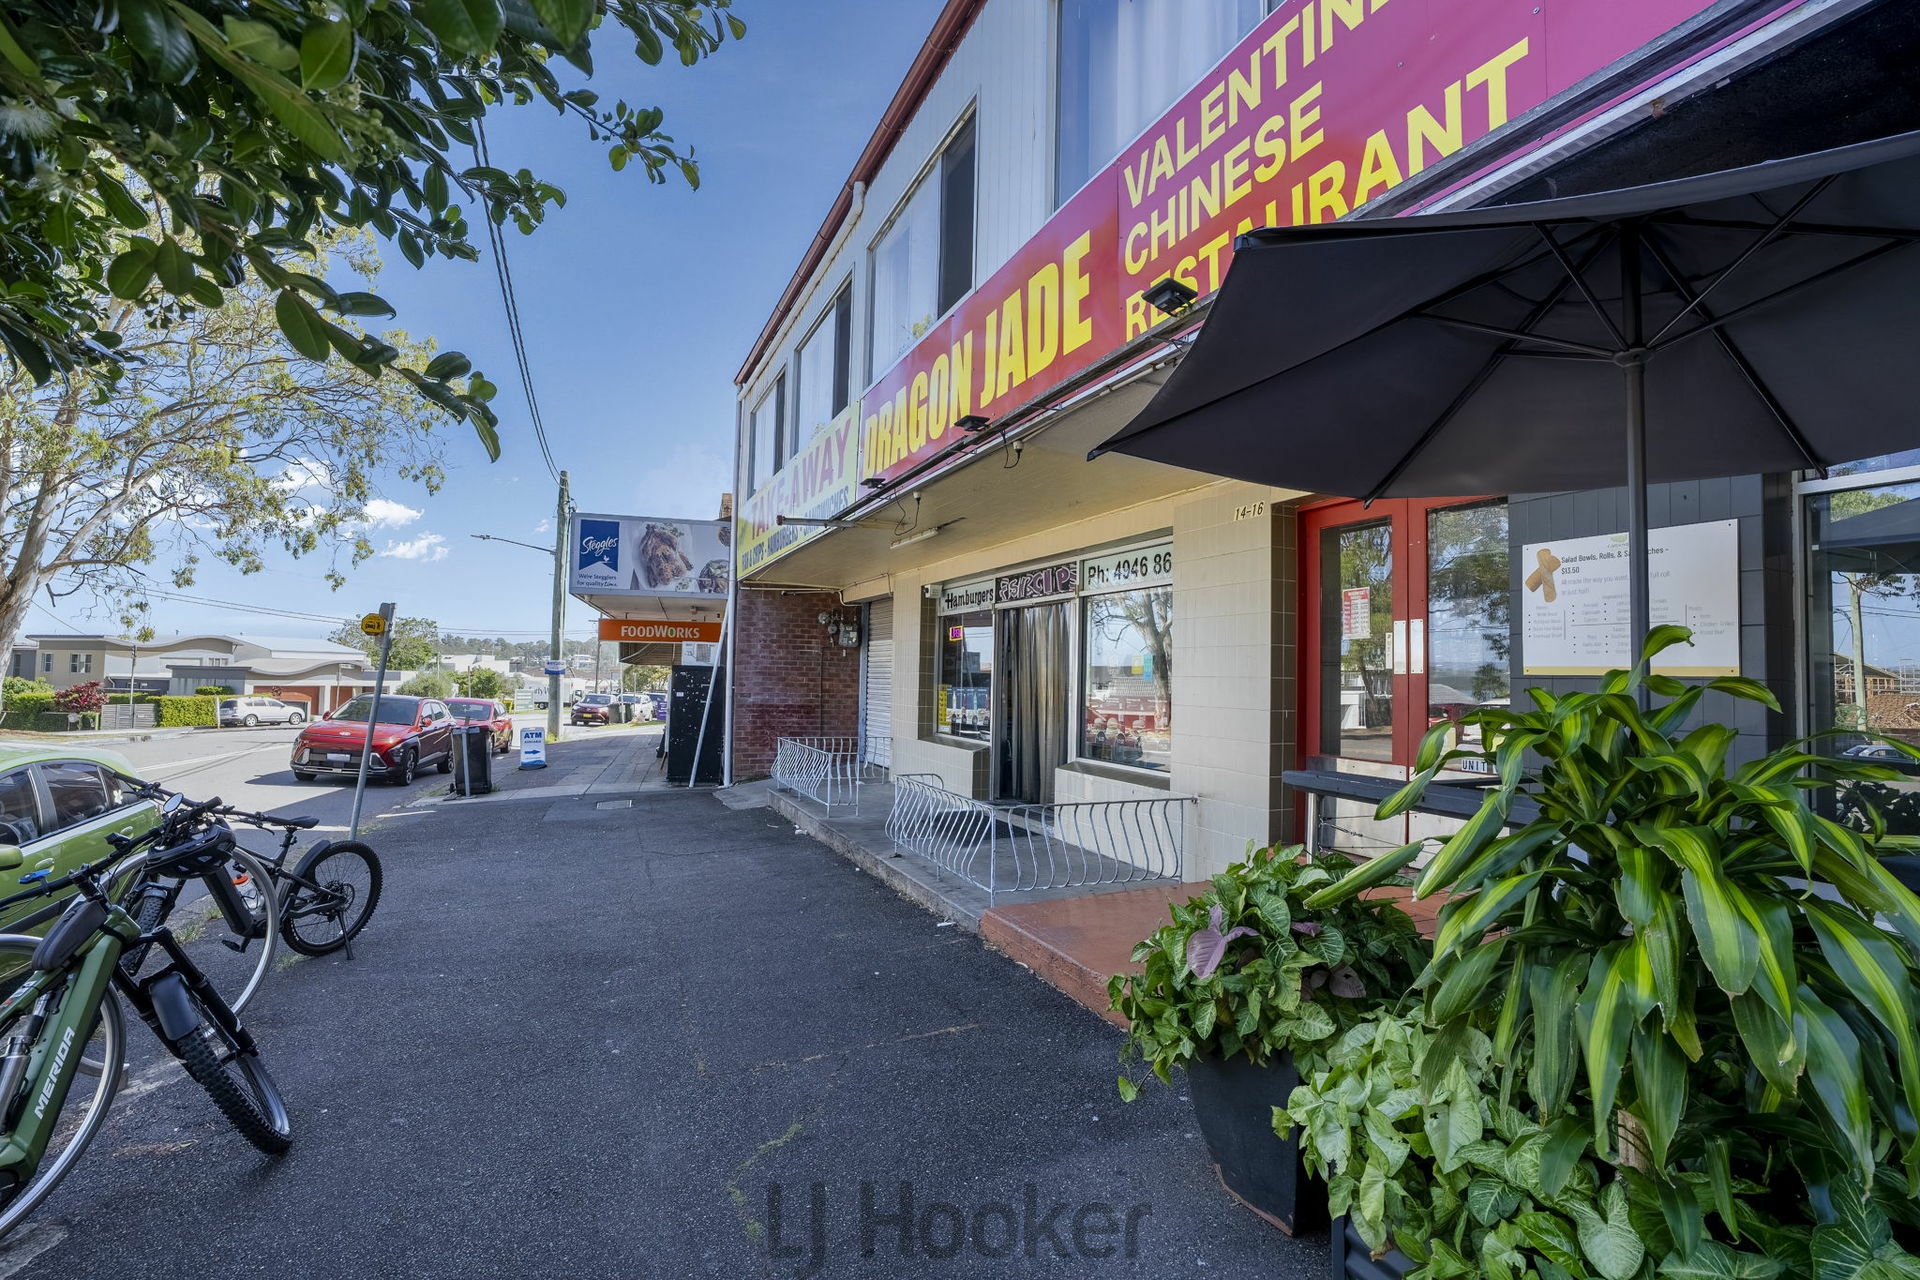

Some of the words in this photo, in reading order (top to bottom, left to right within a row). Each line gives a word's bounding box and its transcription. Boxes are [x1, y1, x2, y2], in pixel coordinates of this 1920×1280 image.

[1124, 0, 1389, 208] VALENTIN
[1125, 80, 1324, 275] CHINESE
[862, 330, 973, 479] DRAGON
[980, 229, 1092, 408] JADE
[1235, 501, 1264, 521] 14-16
[580, 536, 619, 557] Steggles
[1561, 556, 1577, 564] Salad
[1617, 550, 1622, 558] &
[1088, 565, 1109, 585] Ph:
[1114, 557, 1148, 580] 4946
[1561, 566, 1580, 574] $13.50
[945, 588, 994, 610] Hamburgers
[1462, 759, 1486, 772] UNIT
[34, 1026, 76, 1120] MERIDA
